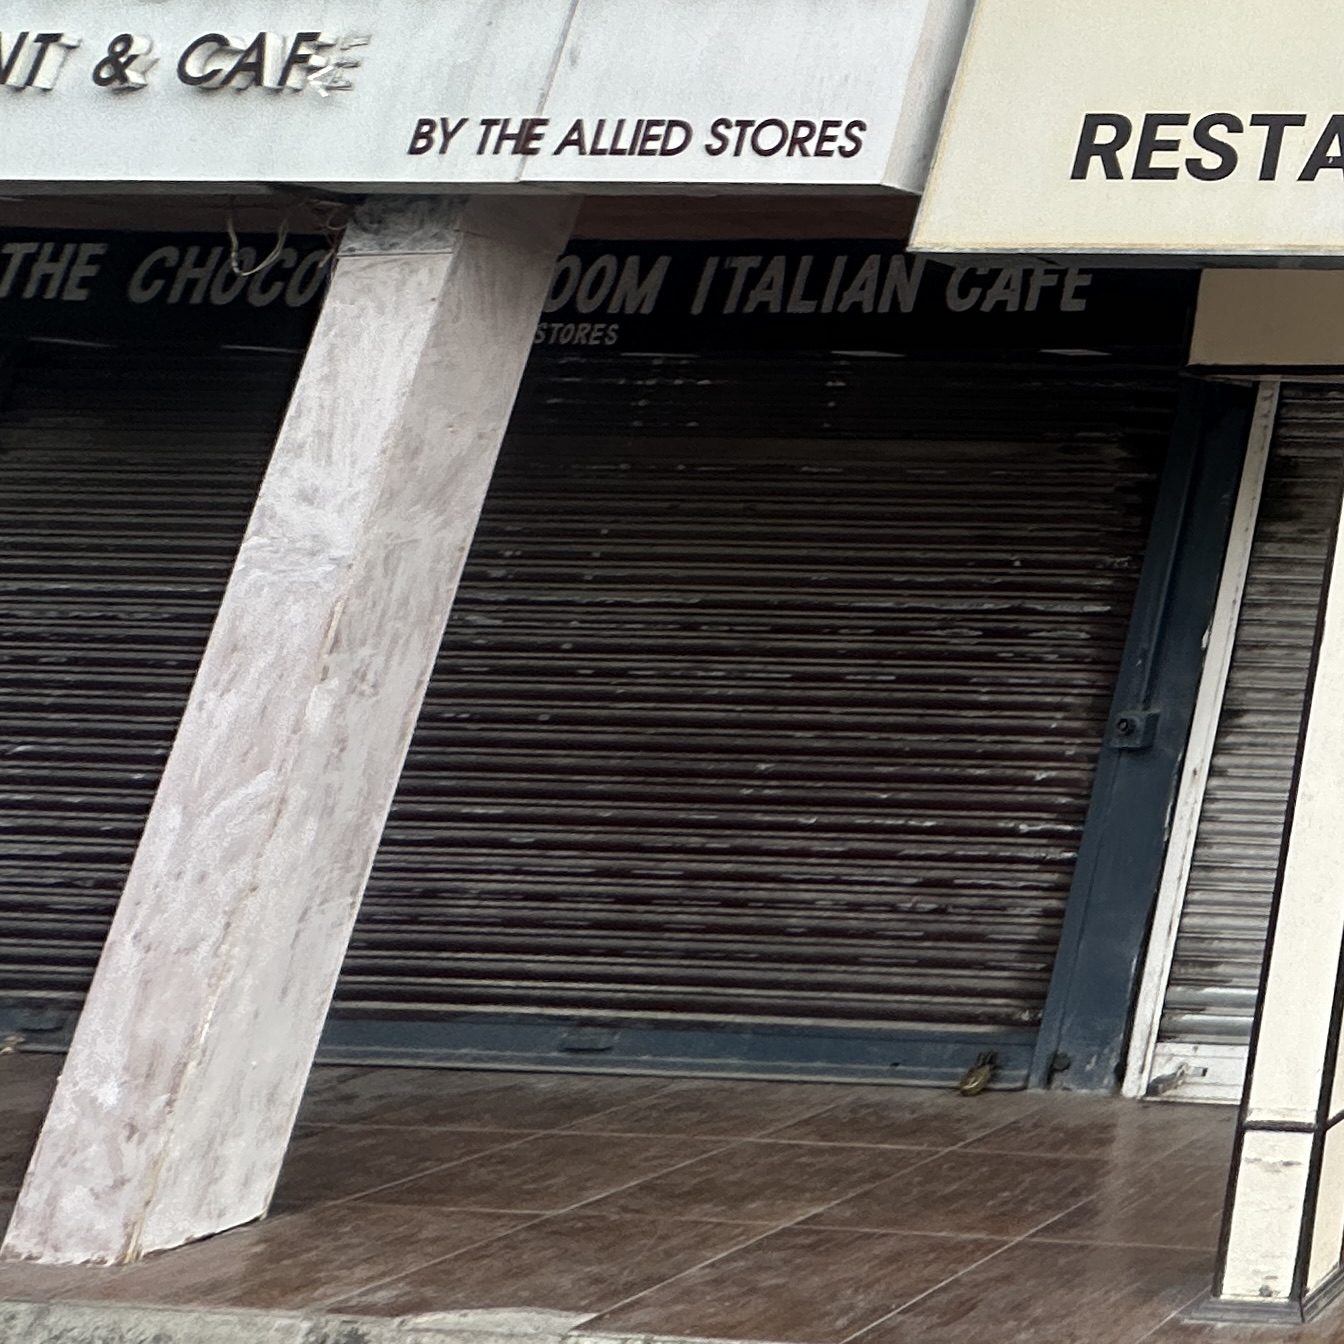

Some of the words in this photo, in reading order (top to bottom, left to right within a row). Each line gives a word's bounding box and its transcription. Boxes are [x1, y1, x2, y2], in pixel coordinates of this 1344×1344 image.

[92, 33, 140, 87] &
[407, 117, 470, 156] BY
[476, 118, 550, 157] THE
[553, 118, 694, 158] ALLIED
[704, 118, 868, 159] STORES
[0, 241, 109, 302] THE
[688, 254, 928, 315] ITALIAN
[944, 263, 1094, 312] CAFE
[533, 322, 620, 346] STORES
